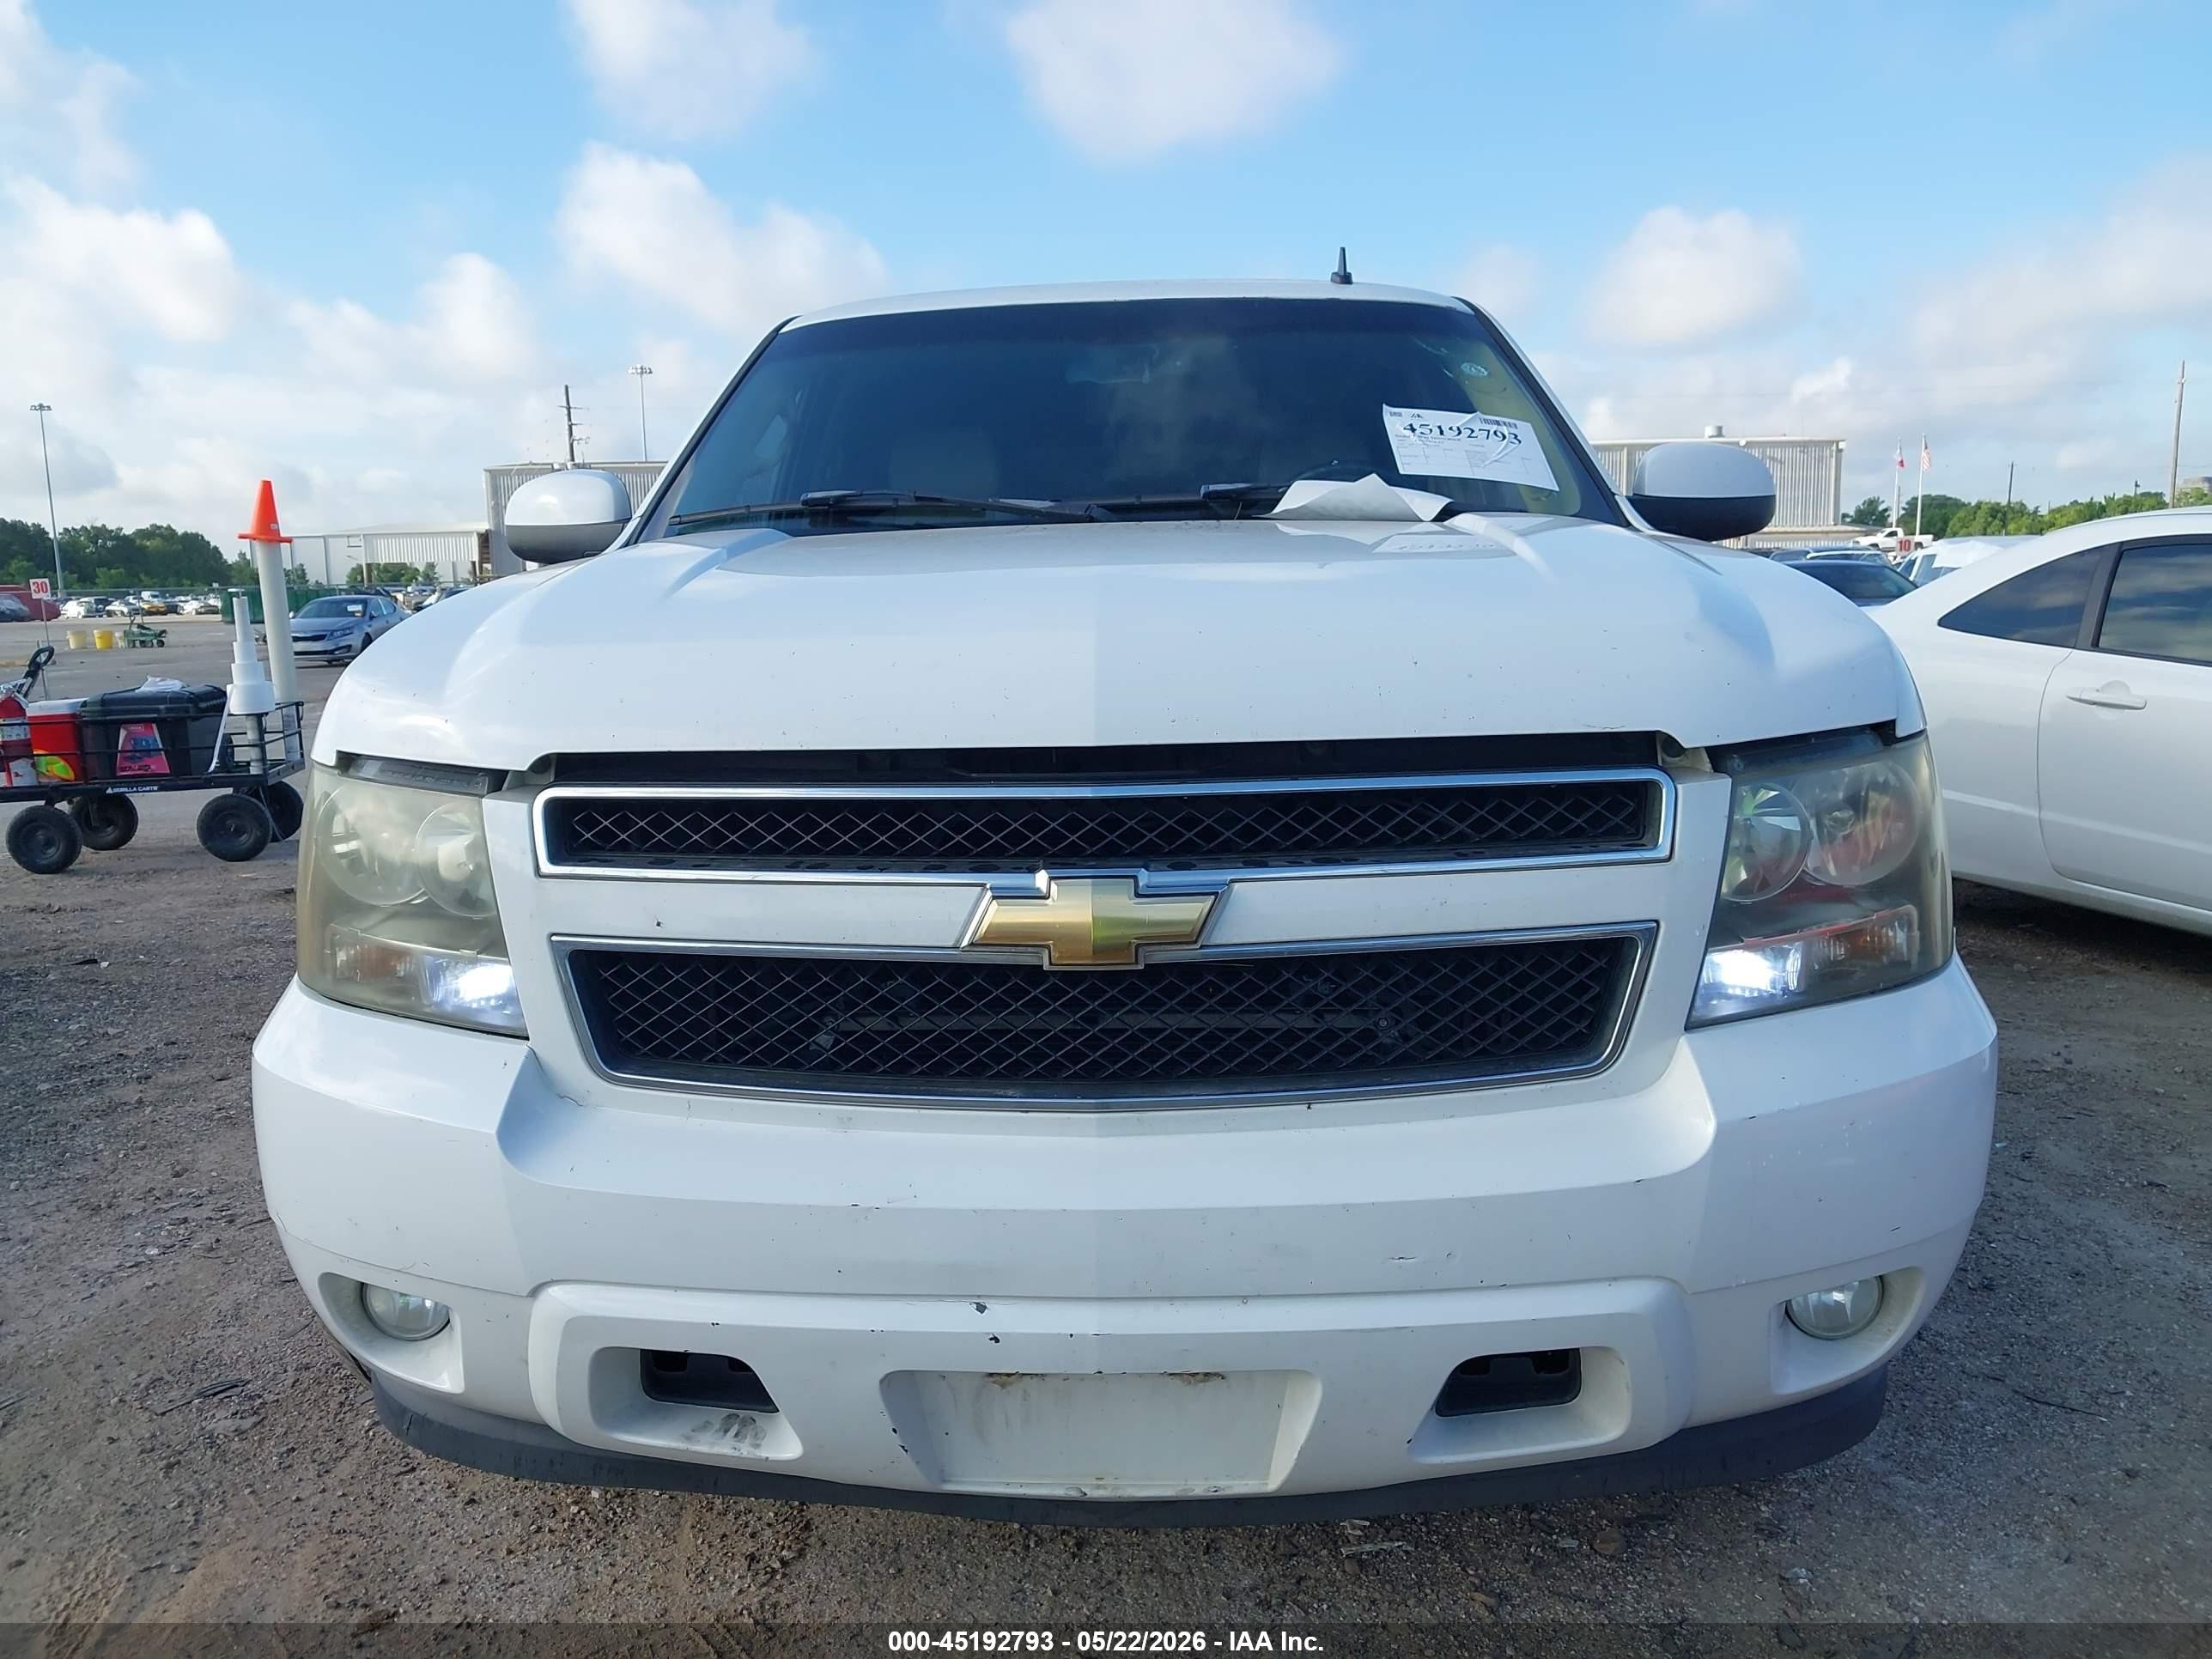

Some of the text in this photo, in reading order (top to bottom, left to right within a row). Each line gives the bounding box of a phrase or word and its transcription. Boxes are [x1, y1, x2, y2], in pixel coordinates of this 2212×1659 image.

[1402, 422, 1522, 447] 45192793
[1898, 539, 1911, 551] 10
[33, 580, 48, 594] 30
